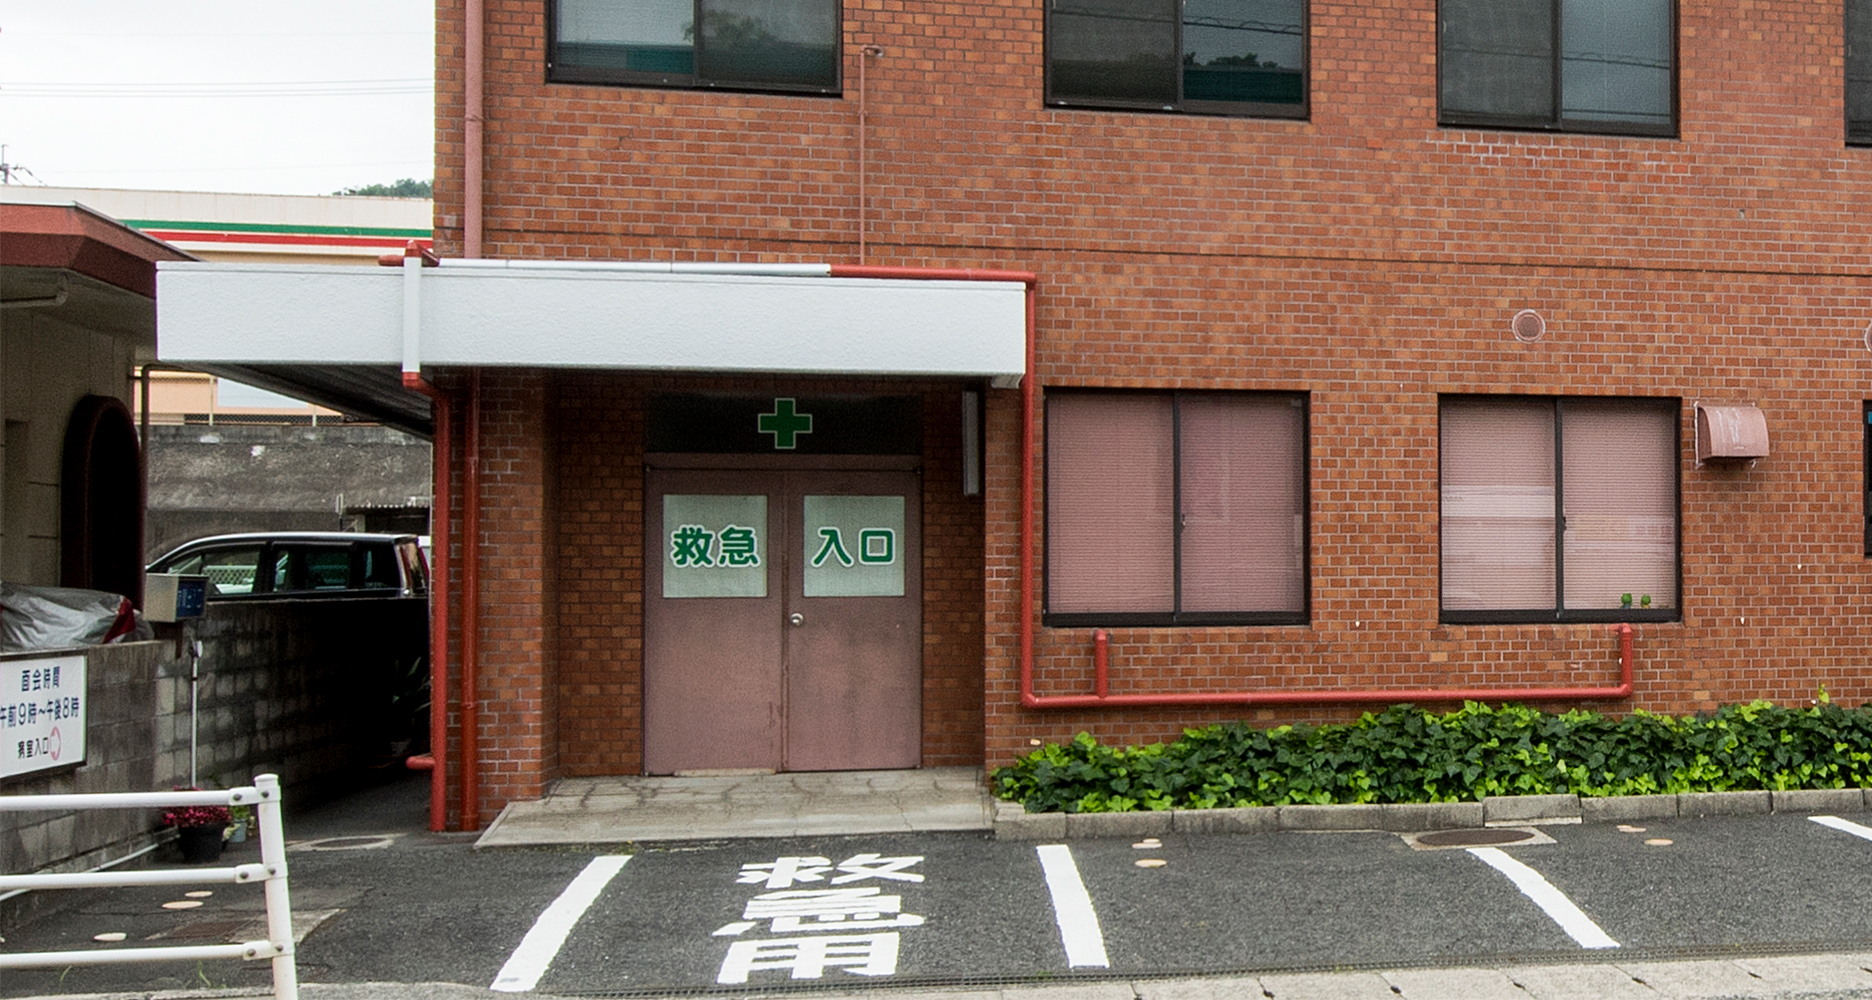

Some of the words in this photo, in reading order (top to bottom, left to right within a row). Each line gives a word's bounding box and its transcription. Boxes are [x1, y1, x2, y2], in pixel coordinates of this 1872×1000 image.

[670, 524, 761, 568] 救急
[810, 526, 896, 567] 入口
[21, 665, 61, 692] 面会時間
[711, 853, 926, 985] 救急用
